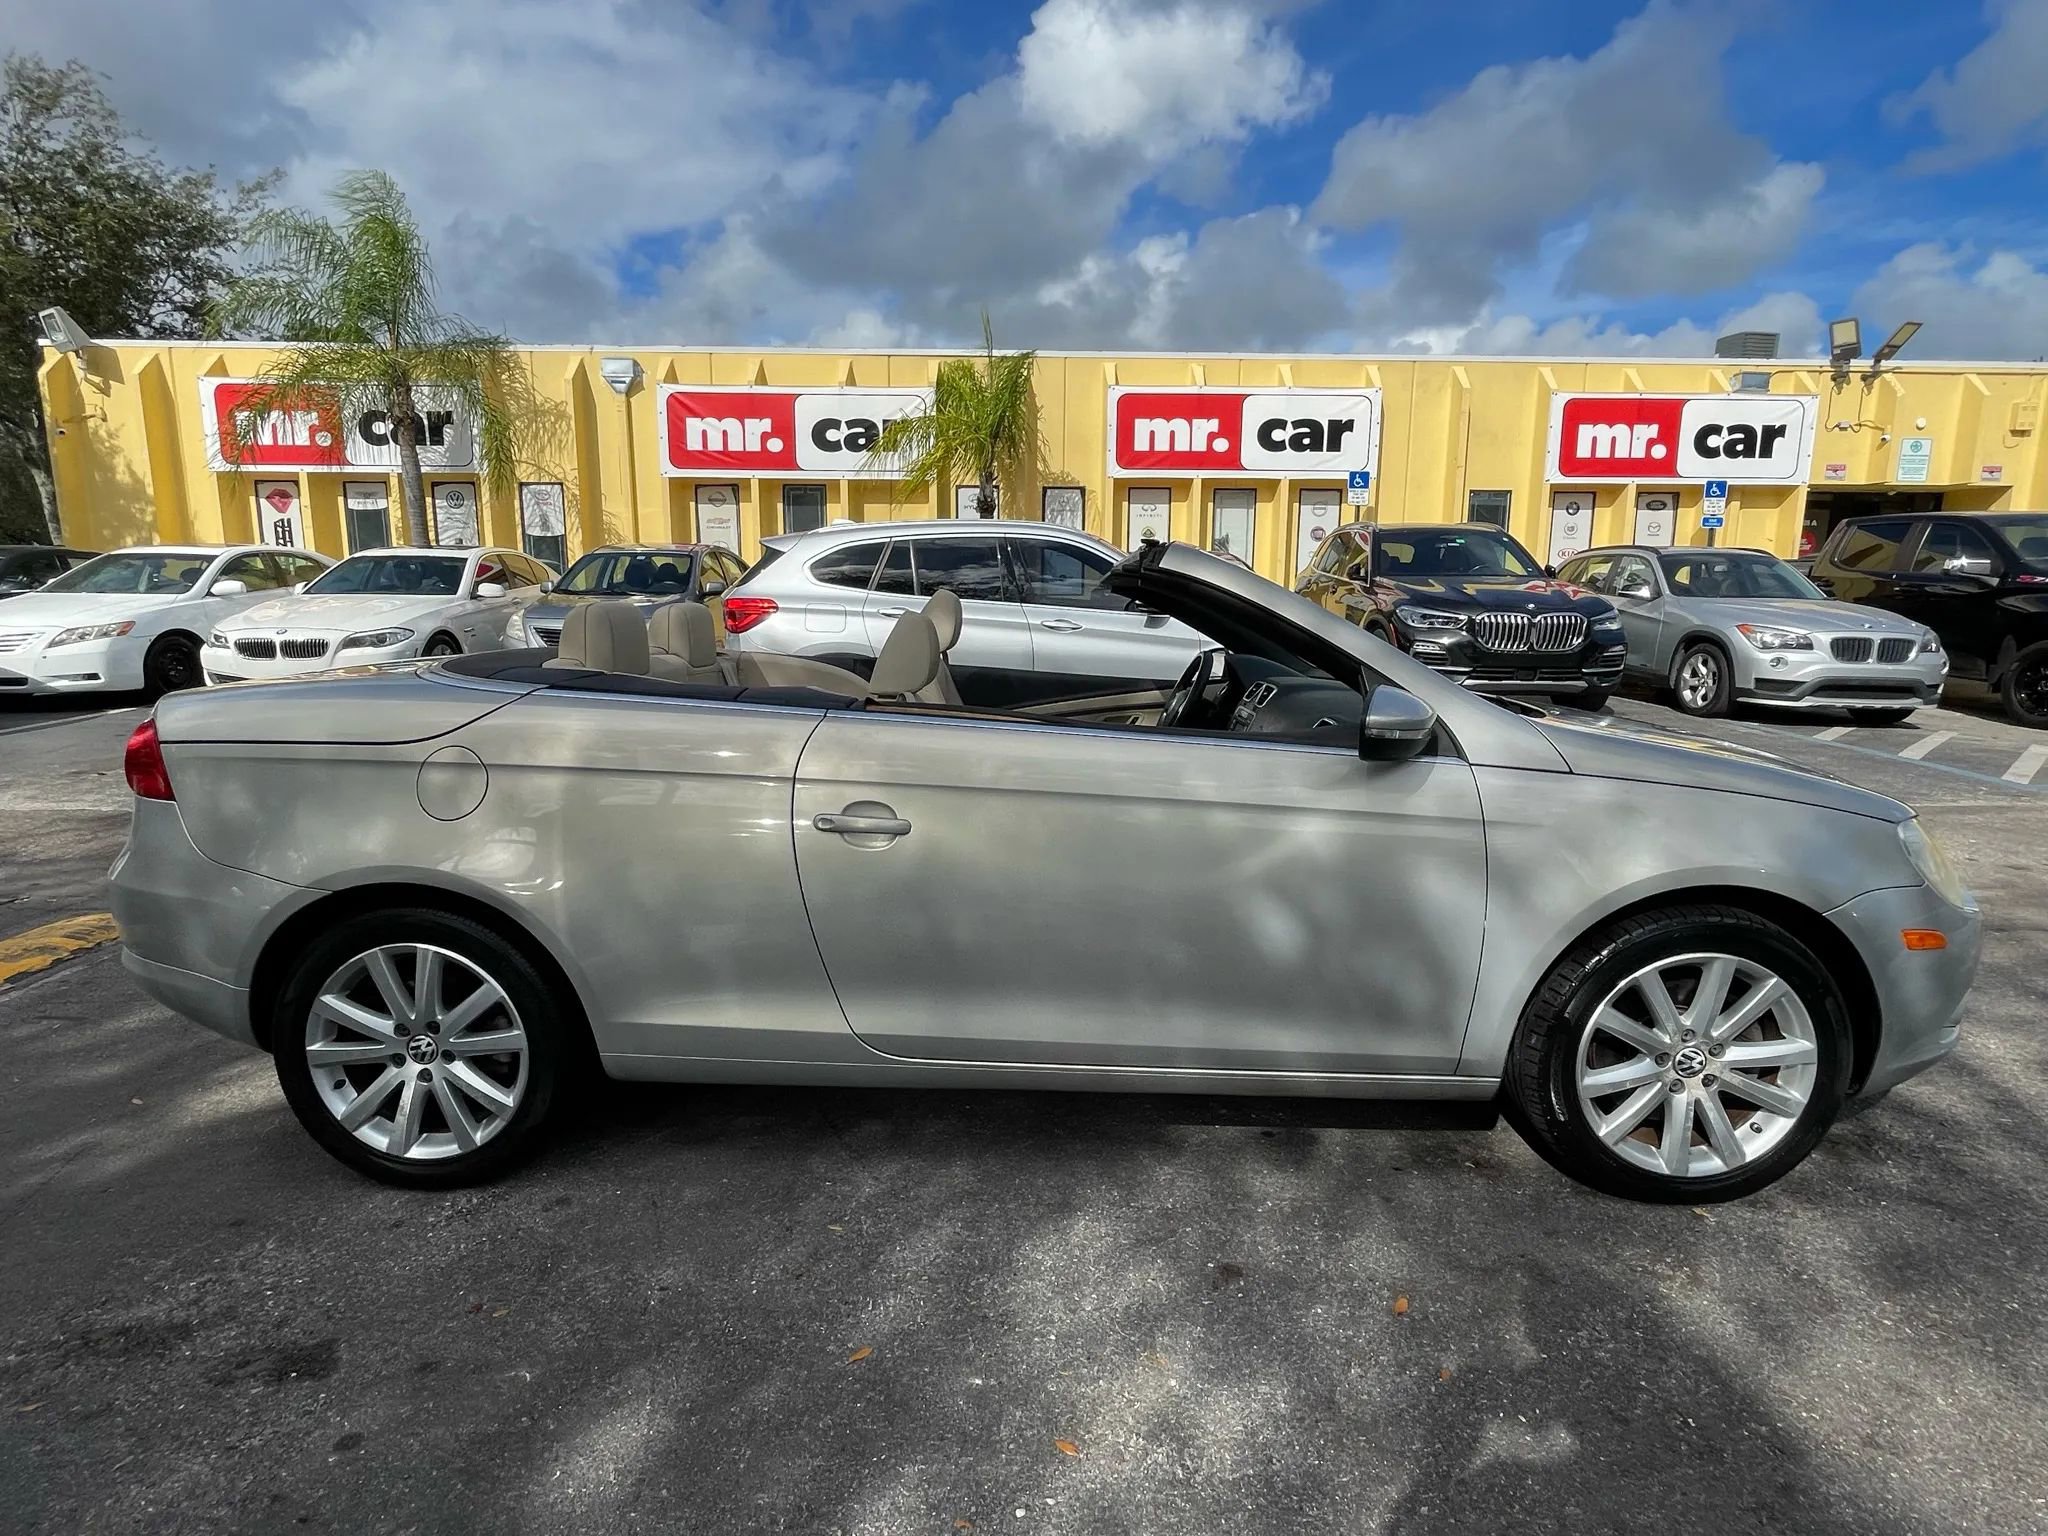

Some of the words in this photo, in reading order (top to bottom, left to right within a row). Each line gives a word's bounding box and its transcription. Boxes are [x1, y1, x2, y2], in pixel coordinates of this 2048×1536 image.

[234, 409, 332, 447] mr.
[685, 416, 784, 453] mr.
[1133, 416, 1230, 453] mr.
[1257, 417, 1355, 453] car
[1575, 423, 1668, 460] mr.
[1693, 423, 1787, 459] car
